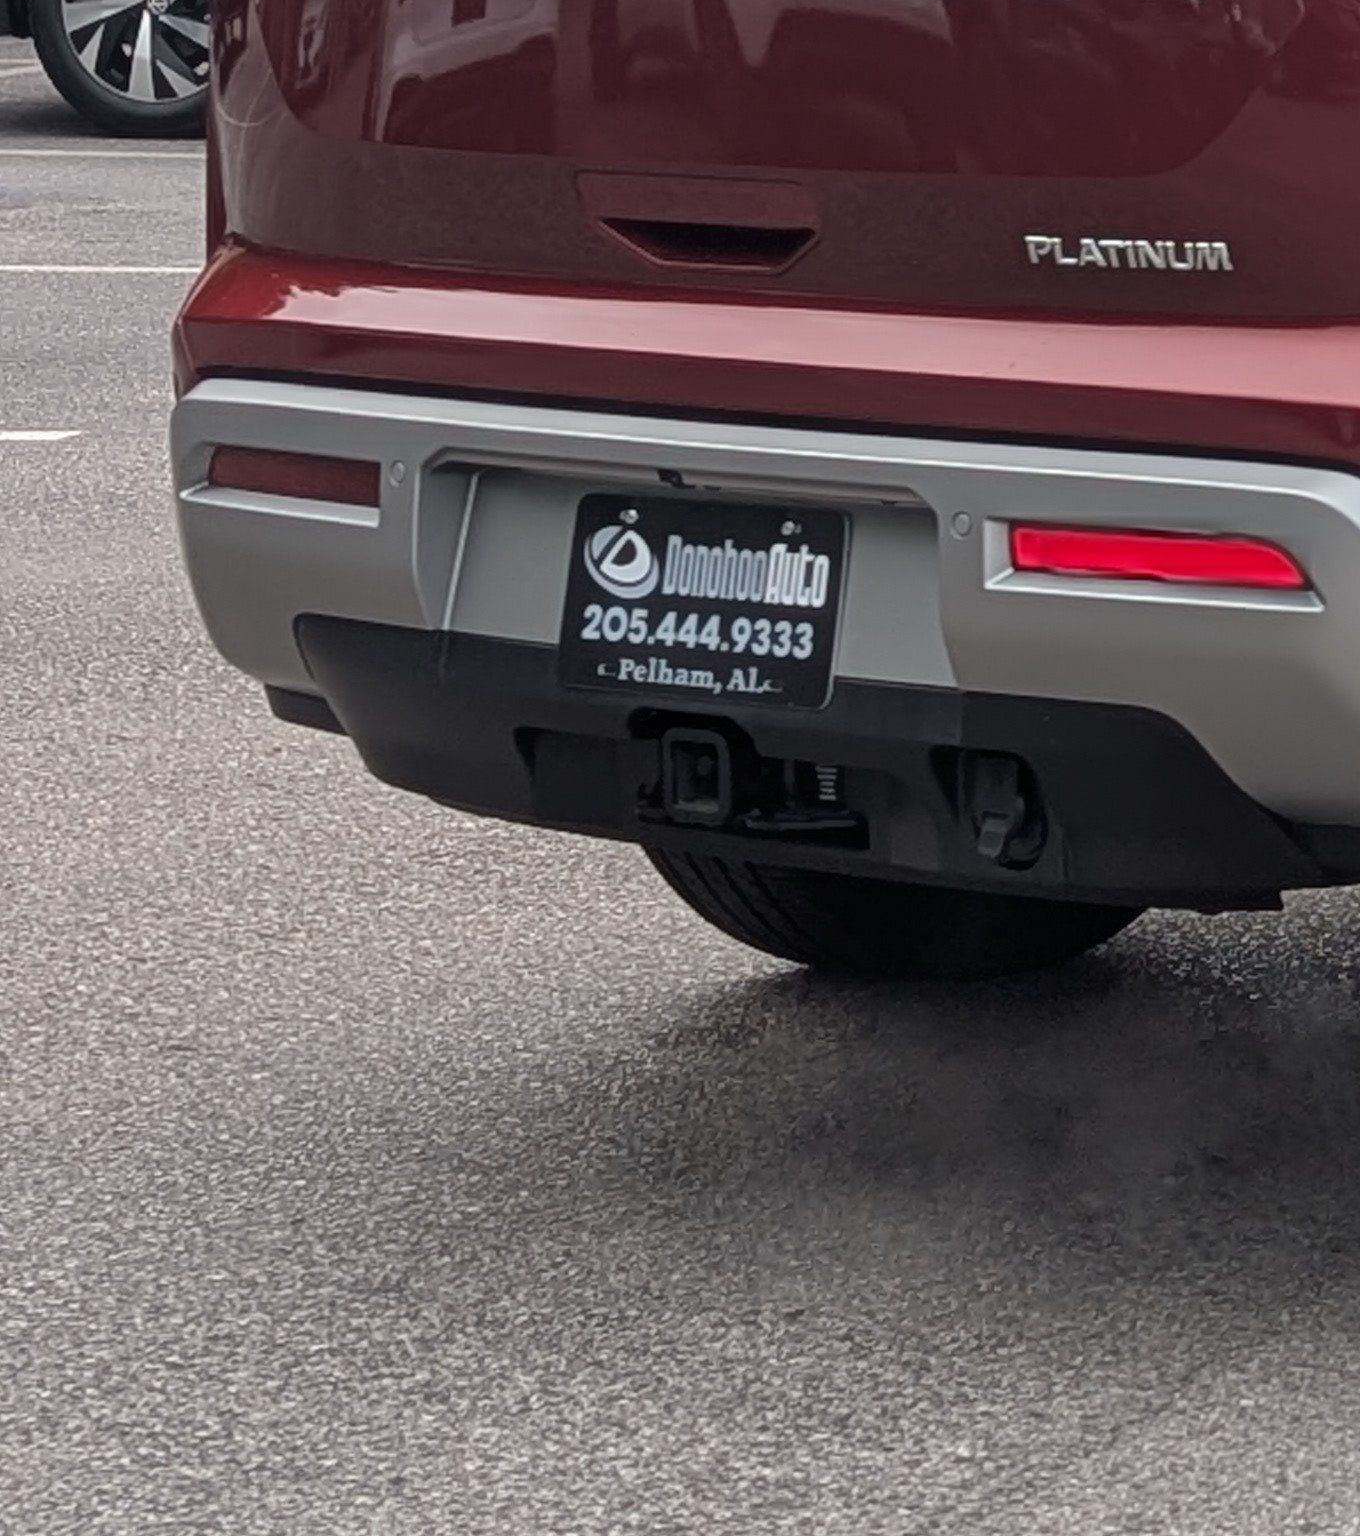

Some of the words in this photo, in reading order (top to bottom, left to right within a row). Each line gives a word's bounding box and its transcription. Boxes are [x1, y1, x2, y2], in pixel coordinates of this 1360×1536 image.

[1023, 235, 1234, 271] PLATINUM
[580, 604, 815, 660] 205.444.9333
[617, 657, 722, 695] Pelham,
